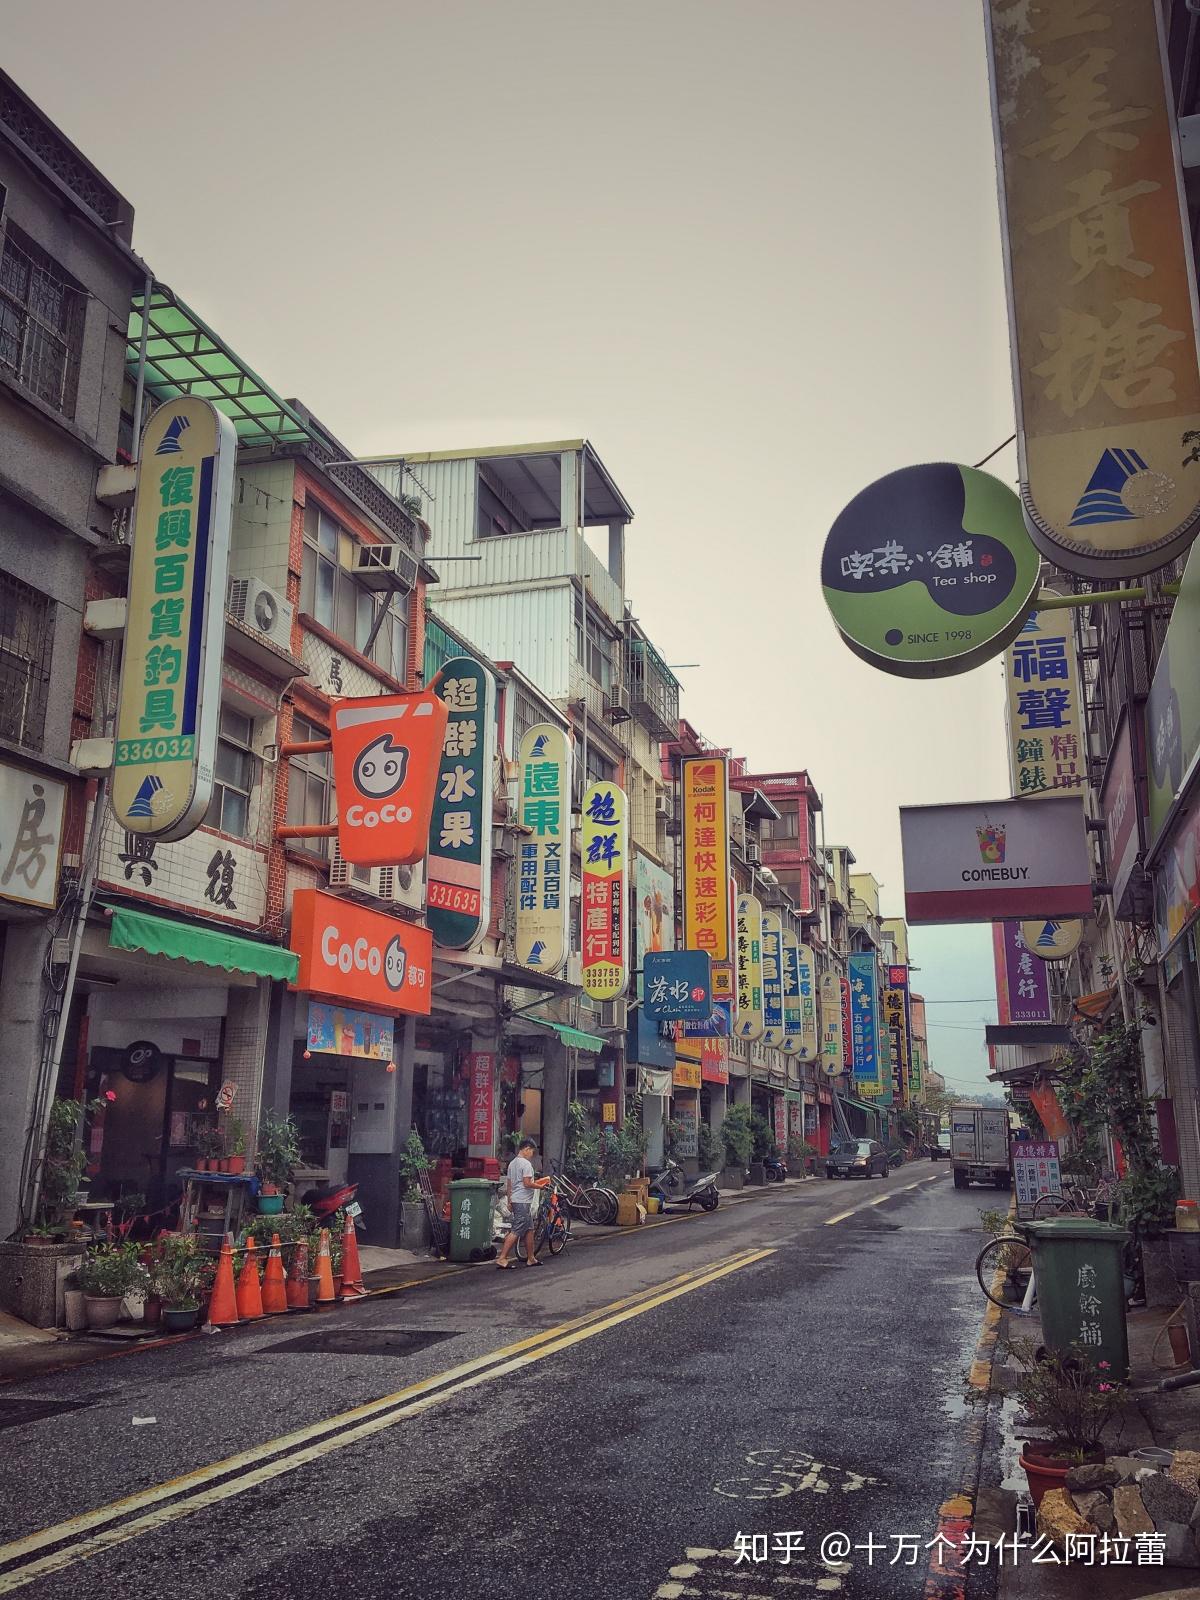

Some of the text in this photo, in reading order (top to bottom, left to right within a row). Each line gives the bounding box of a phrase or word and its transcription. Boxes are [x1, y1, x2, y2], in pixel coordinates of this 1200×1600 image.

[138, 466, 195, 734] 復興百貨釣具
[932, 572, 997, 587] Tea shop
[907, 630, 972, 645] SINCE 1998
[1012, 637, 1072, 730] 福聲
[117, 738, 194, 763] 336032
[438, 676, 478, 850] 超群水果
[1049, 733, 1081, 788] 精品
[523, 762, 560, 836] 遠東
[692, 786, 716, 794] Kodak
[345, 803, 413, 829] CoCo
[585, 790, 622, 871] 超群
[429, 885, 479, 913] 331635
[519, 842, 539, 911] 軍用配件
[543, 841, 562, 911] 文具百貨
[693, 802, 718, 950] 柯達快速彩色
[961, 866, 1030, 882] COMEBUY
[585, 881, 609, 957] 特產行
[321, 926, 382, 976] CoCo
[407, 963, 426, 989] 都可
[586, 968, 620, 978] 333755
[586, 979, 620, 988] 332152
[715, 974, 729, 989] 曼
[1015, 1010, 1047, 1018] 333011
[853, 1013, 864, 1066] 五金建材行
[474, 1055, 491, 1143] 超群水菓行
